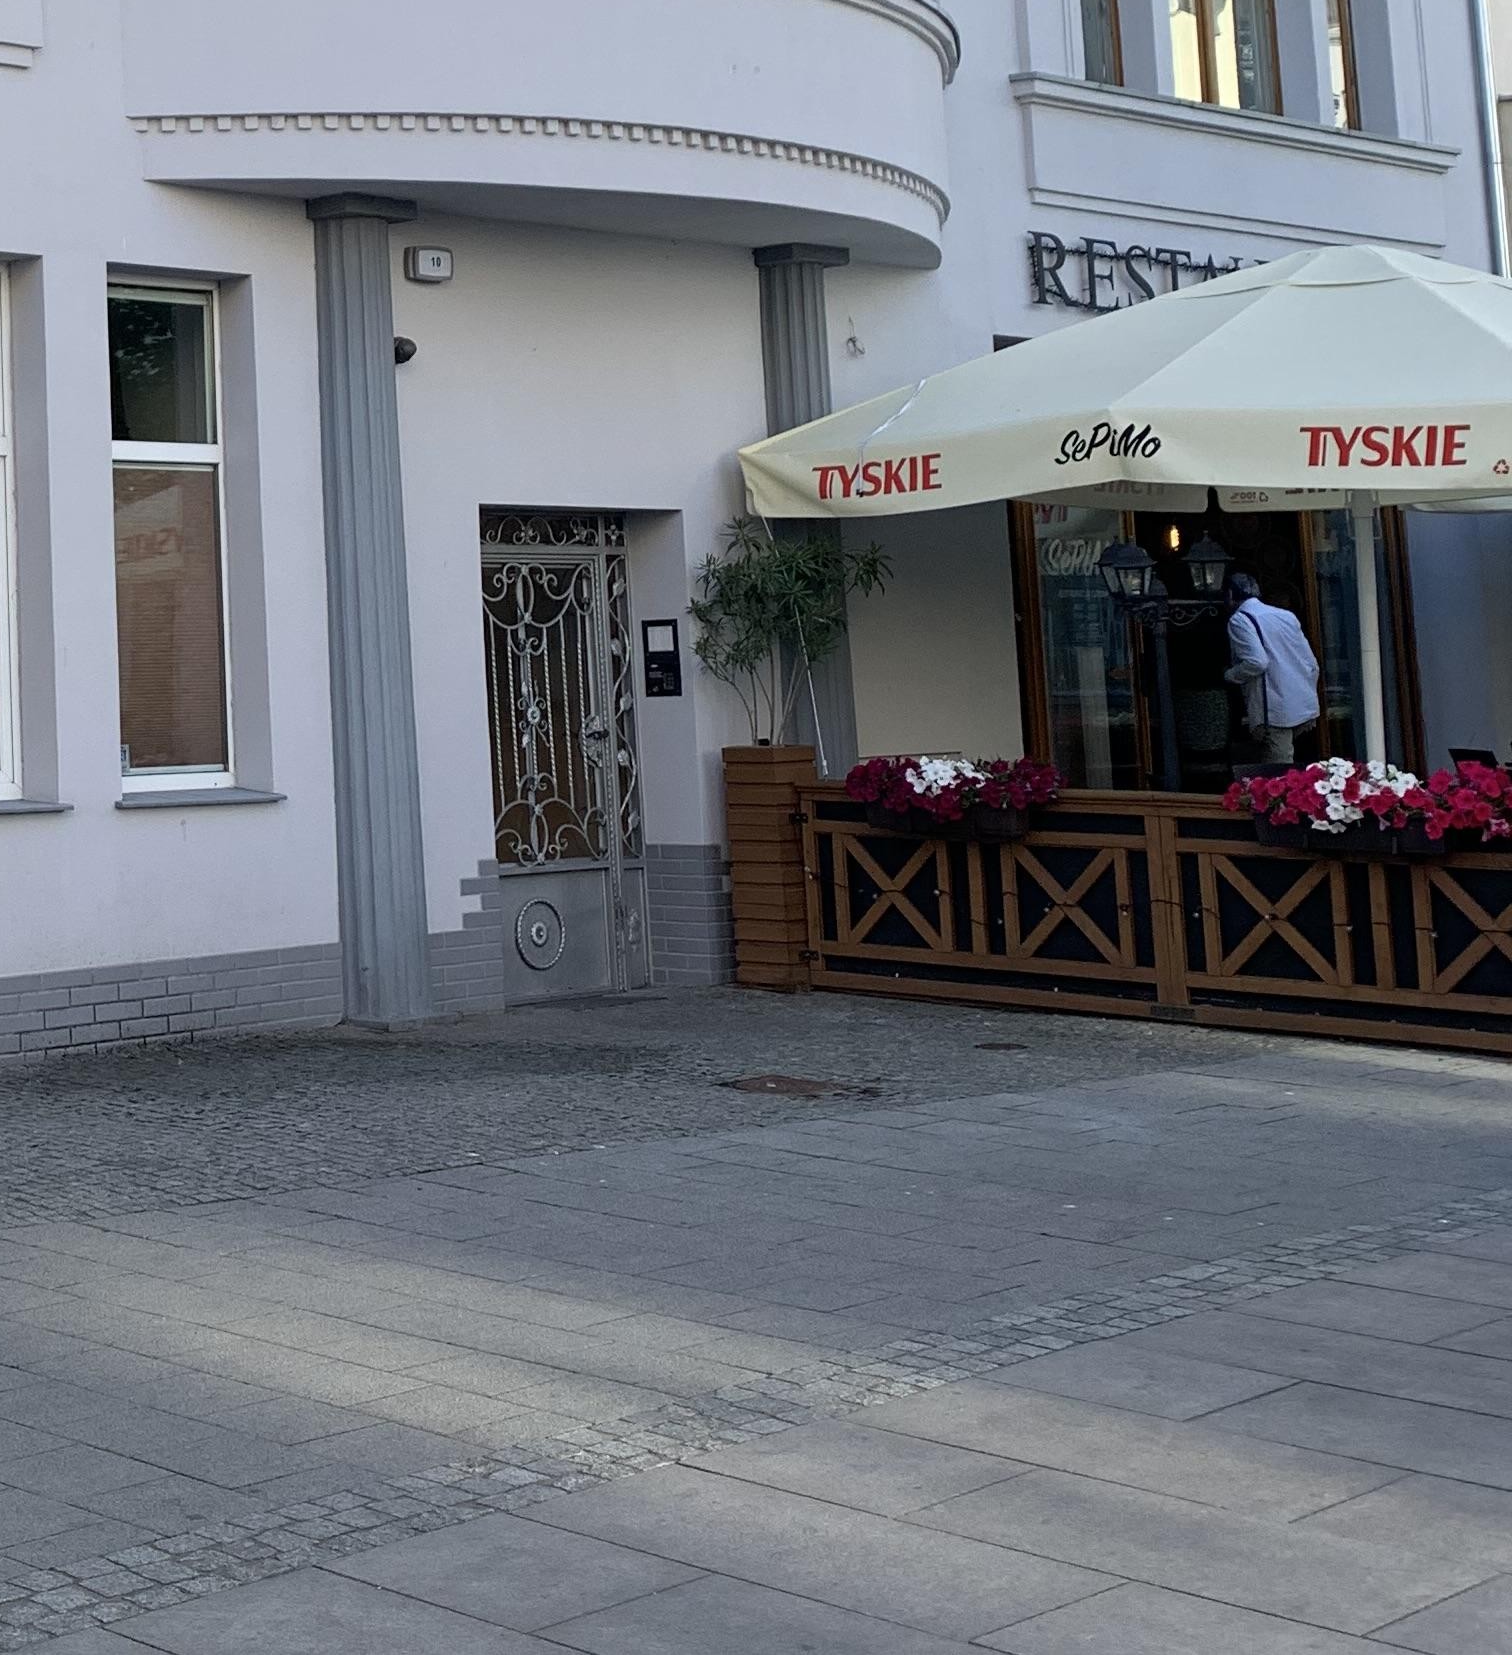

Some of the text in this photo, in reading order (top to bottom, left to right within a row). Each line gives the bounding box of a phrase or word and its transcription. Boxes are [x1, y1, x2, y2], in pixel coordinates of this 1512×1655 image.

[431, 256, 442, 268] 10
[1054, 422, 1161, 465] SePiMo
[1300, 424, 1471, 467] TYSKIE
[812, 453, 943, 500] TYSKIE
